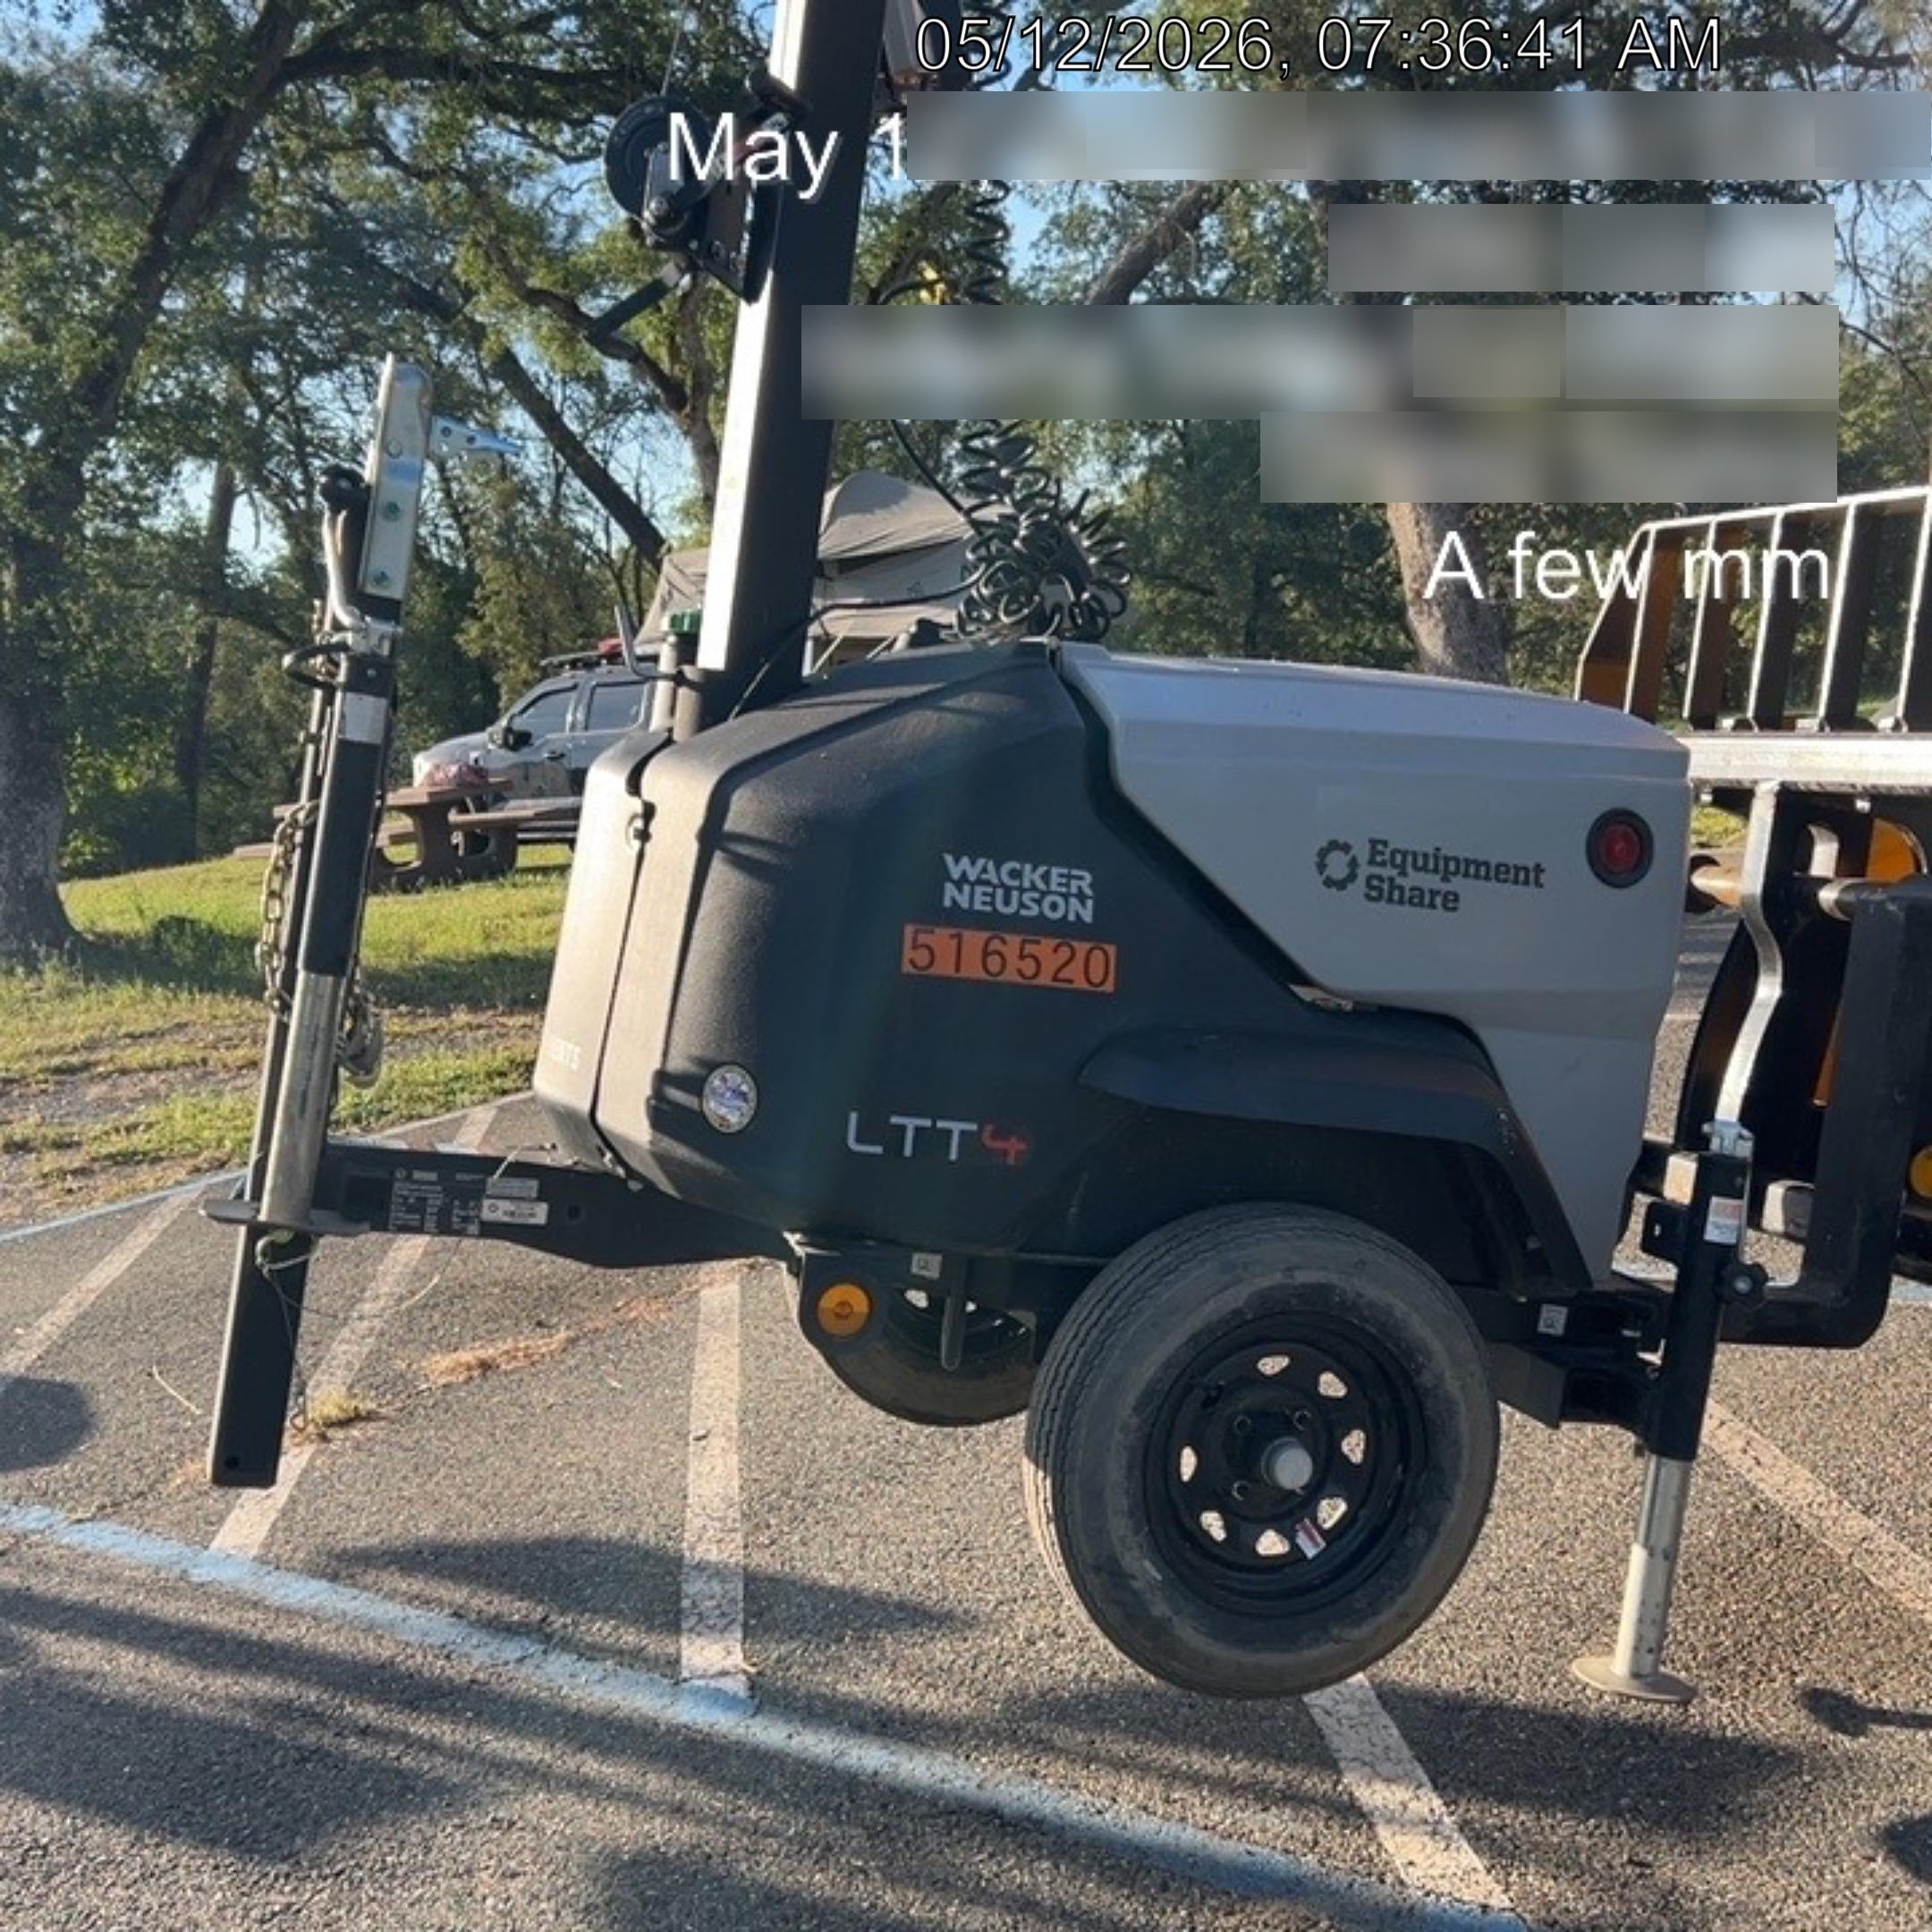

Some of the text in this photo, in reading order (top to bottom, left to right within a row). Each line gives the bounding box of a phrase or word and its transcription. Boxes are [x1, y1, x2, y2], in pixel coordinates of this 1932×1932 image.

[942, 852, 1093, 895] WACKER
[1367, 838, 1546, 888] Equipment
[943, 882, 1093, 924] NEUSON
[1363, 874, 1460, 912] Share
[908, 928, 1110, 988] 516520
[846, 1111, 1027, 1166] LTT4
